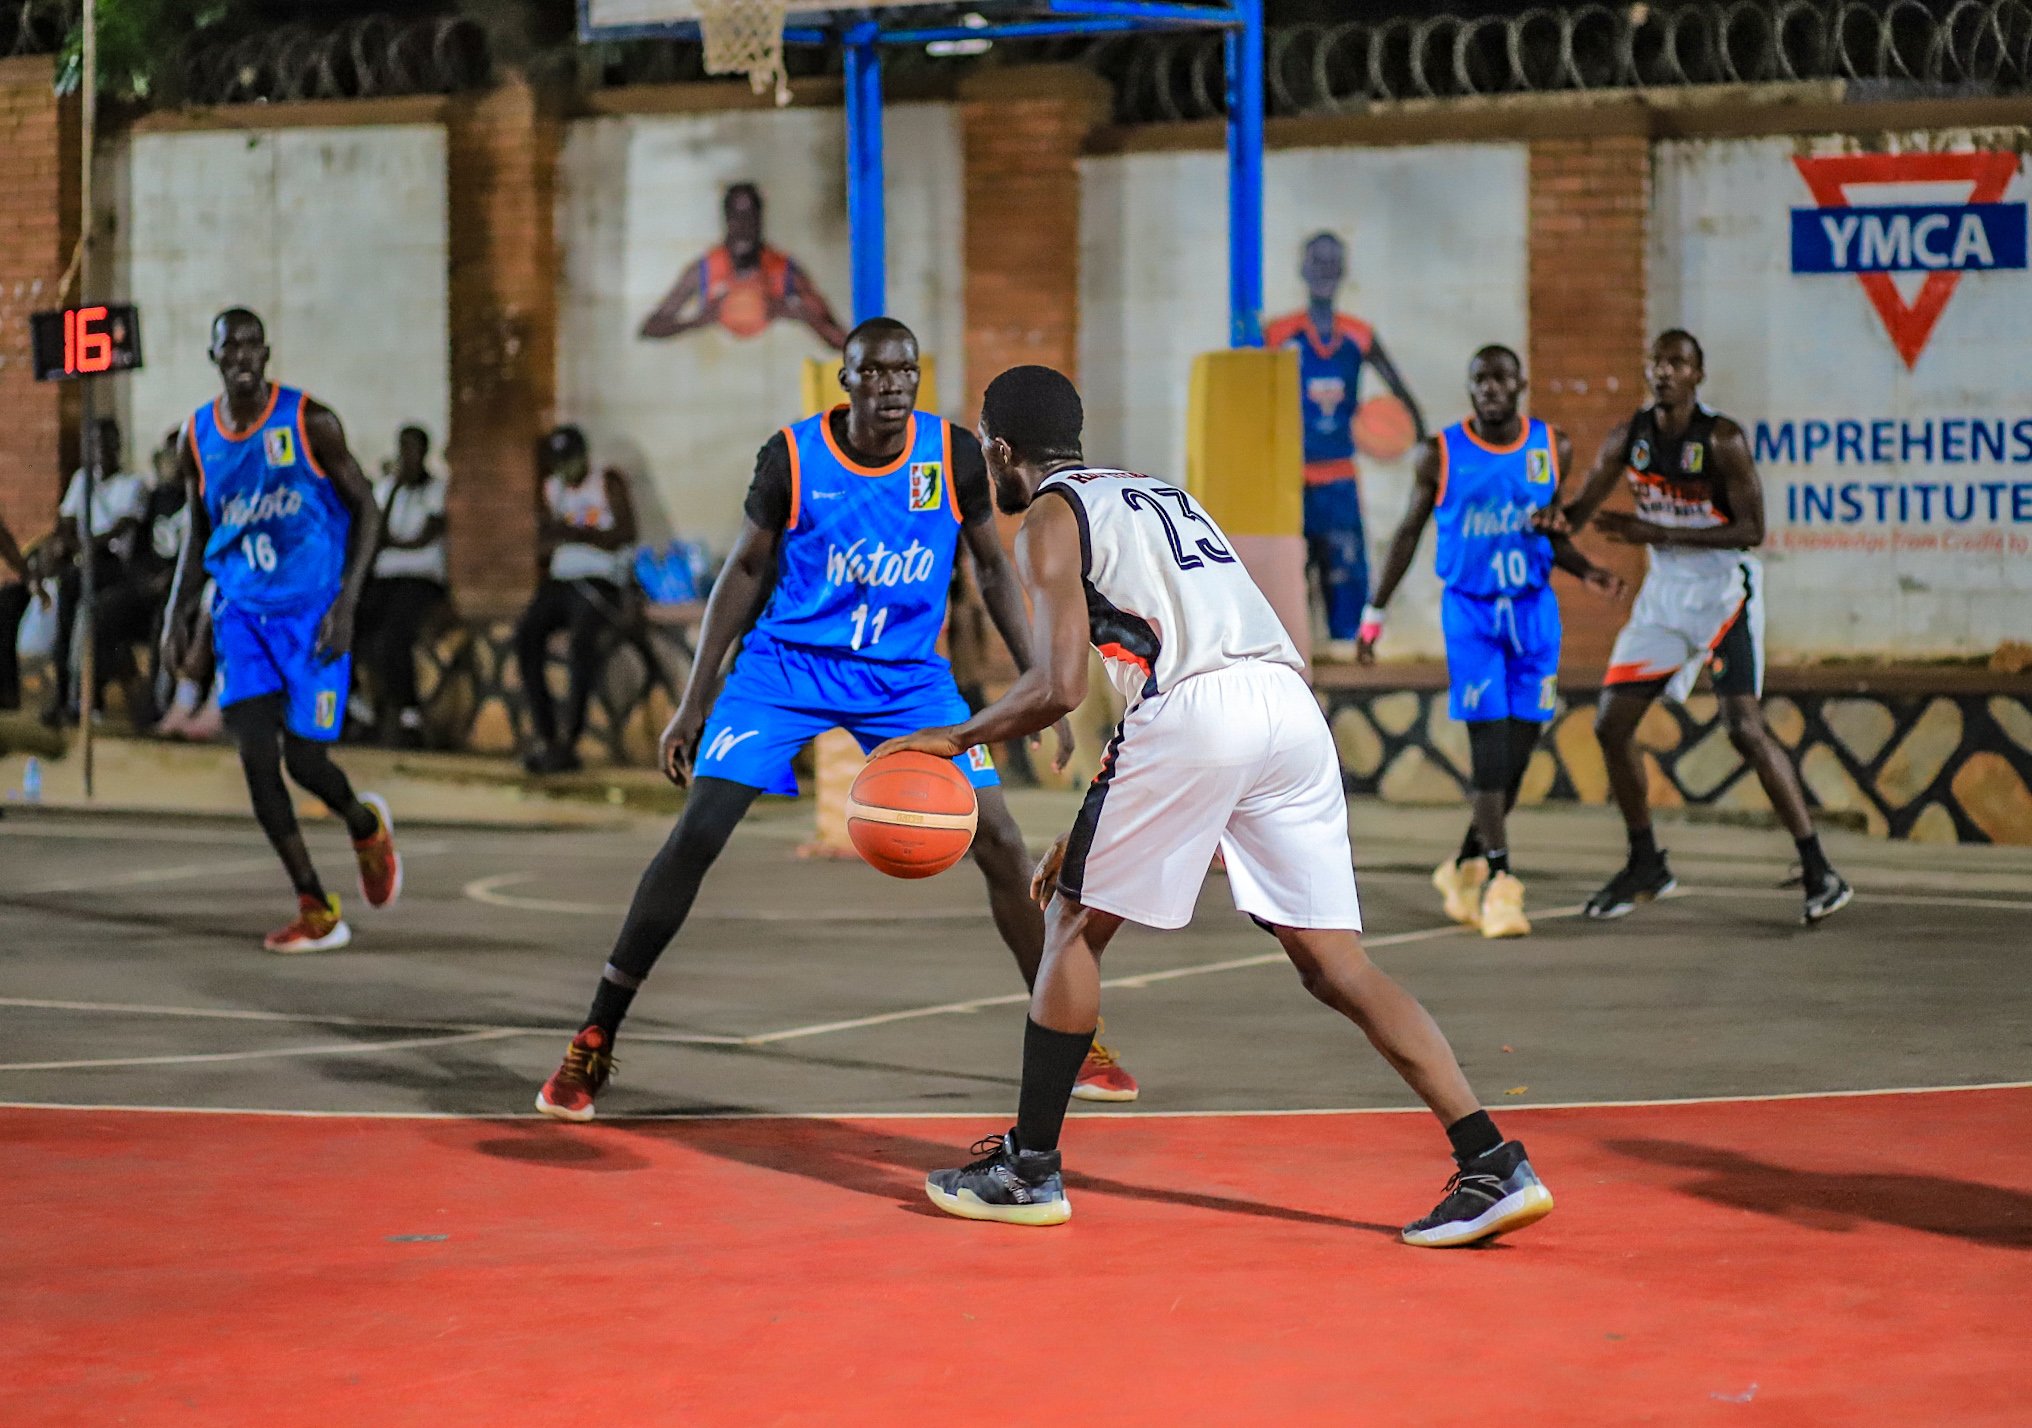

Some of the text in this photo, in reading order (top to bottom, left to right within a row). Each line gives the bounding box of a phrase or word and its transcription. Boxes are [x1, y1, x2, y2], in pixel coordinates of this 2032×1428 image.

[1820, 213, 1995, 269] YMCA
[64, 306, 112, 375] 16
[1754, 418, 2032, 464] MPREHENS
[1462, 498, 1538, 538] Watot
[1787, 481, 2032, 524] INSTITUTE
[1121, 487, 1237, 571] 23
[241, 533, 277, 573] 16
[826, 537, 935, 588] Watoto
[1491, 550, 1527, 588] 10
[850, 603, 888, 651] 11
